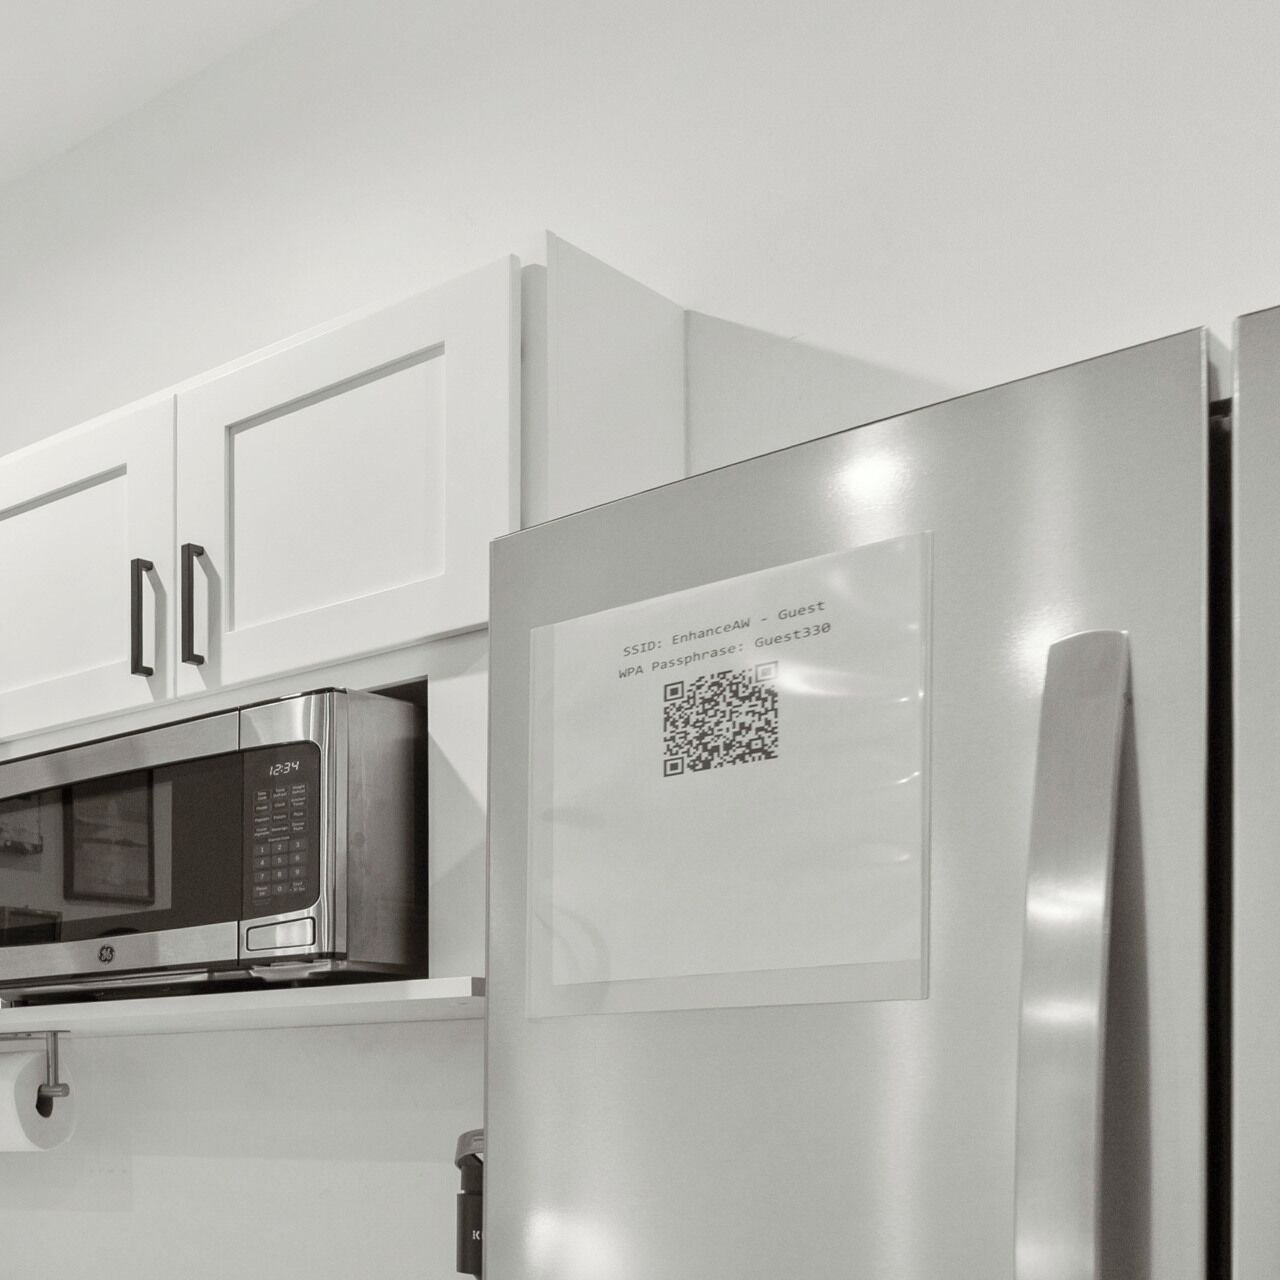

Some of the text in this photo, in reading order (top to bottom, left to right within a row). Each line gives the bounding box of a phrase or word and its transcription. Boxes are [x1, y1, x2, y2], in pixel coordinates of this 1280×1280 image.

[618, 622, 832, 679] WPA Passphrase: Guest330
[623, 640, 662, 657] SSID:
[671, 617, 751, 645] EnhanceAW
[777, 601, 825, 621] Guest
[269, 760, 299, 776] 12:34
